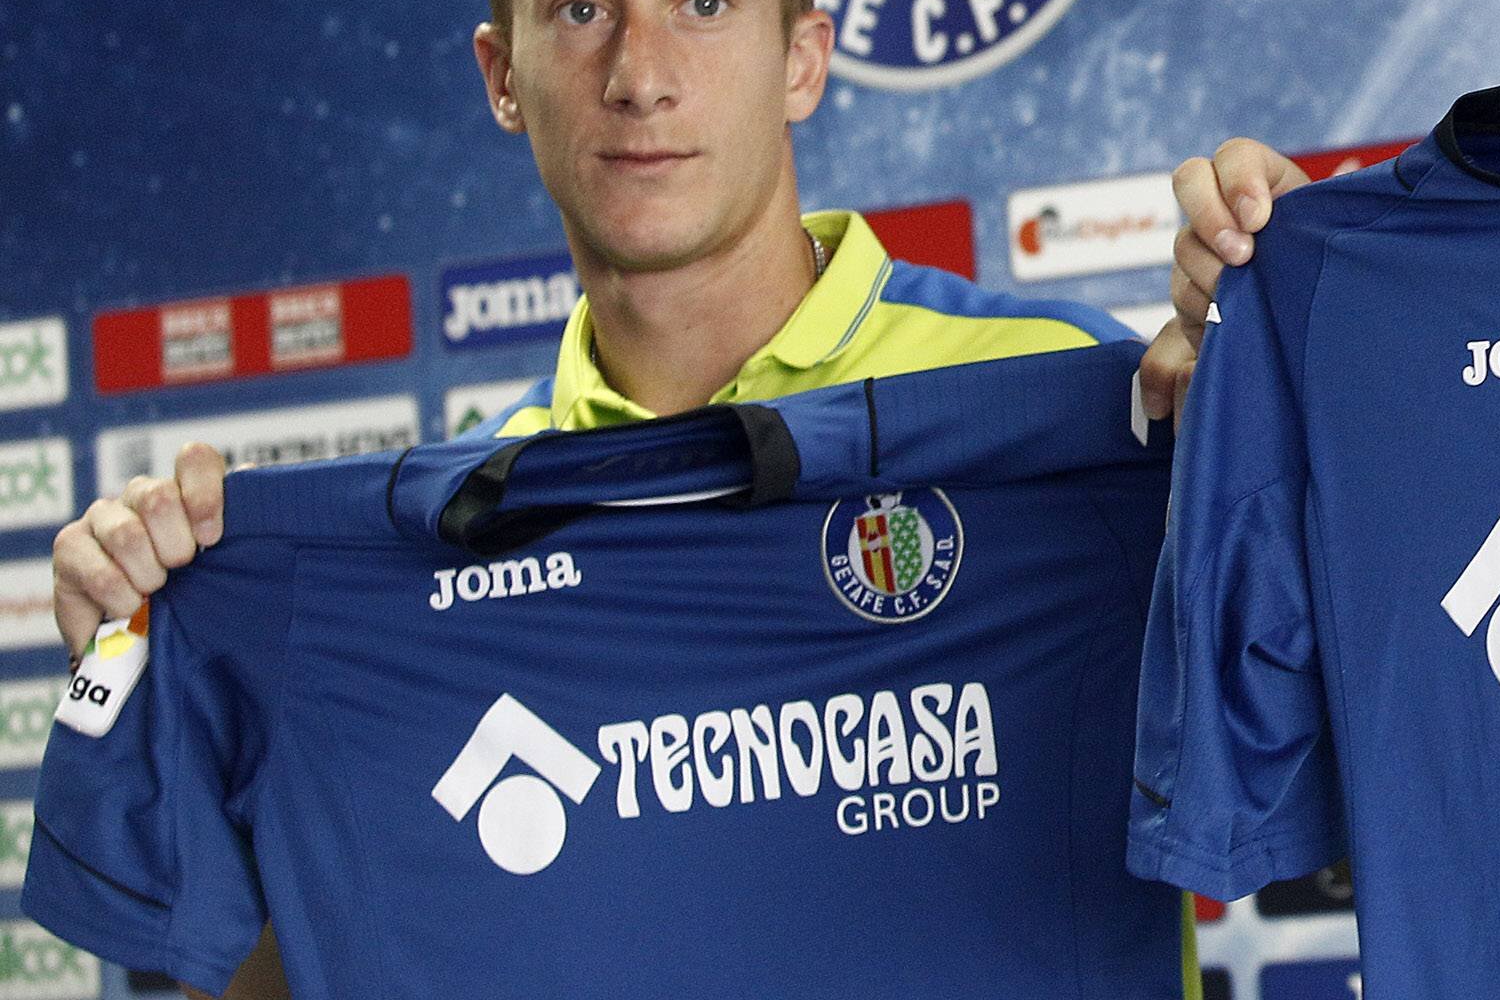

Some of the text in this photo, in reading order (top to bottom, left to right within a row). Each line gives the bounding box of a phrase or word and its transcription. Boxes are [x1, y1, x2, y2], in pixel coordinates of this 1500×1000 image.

[831, 534, 954, 616] GETAFE C.F. S.A.D.
[68, 675, 112, 707] ga
[597, 682, 998, 820] TECNOCASA
[836, 782, 1001, 836] GROUP
